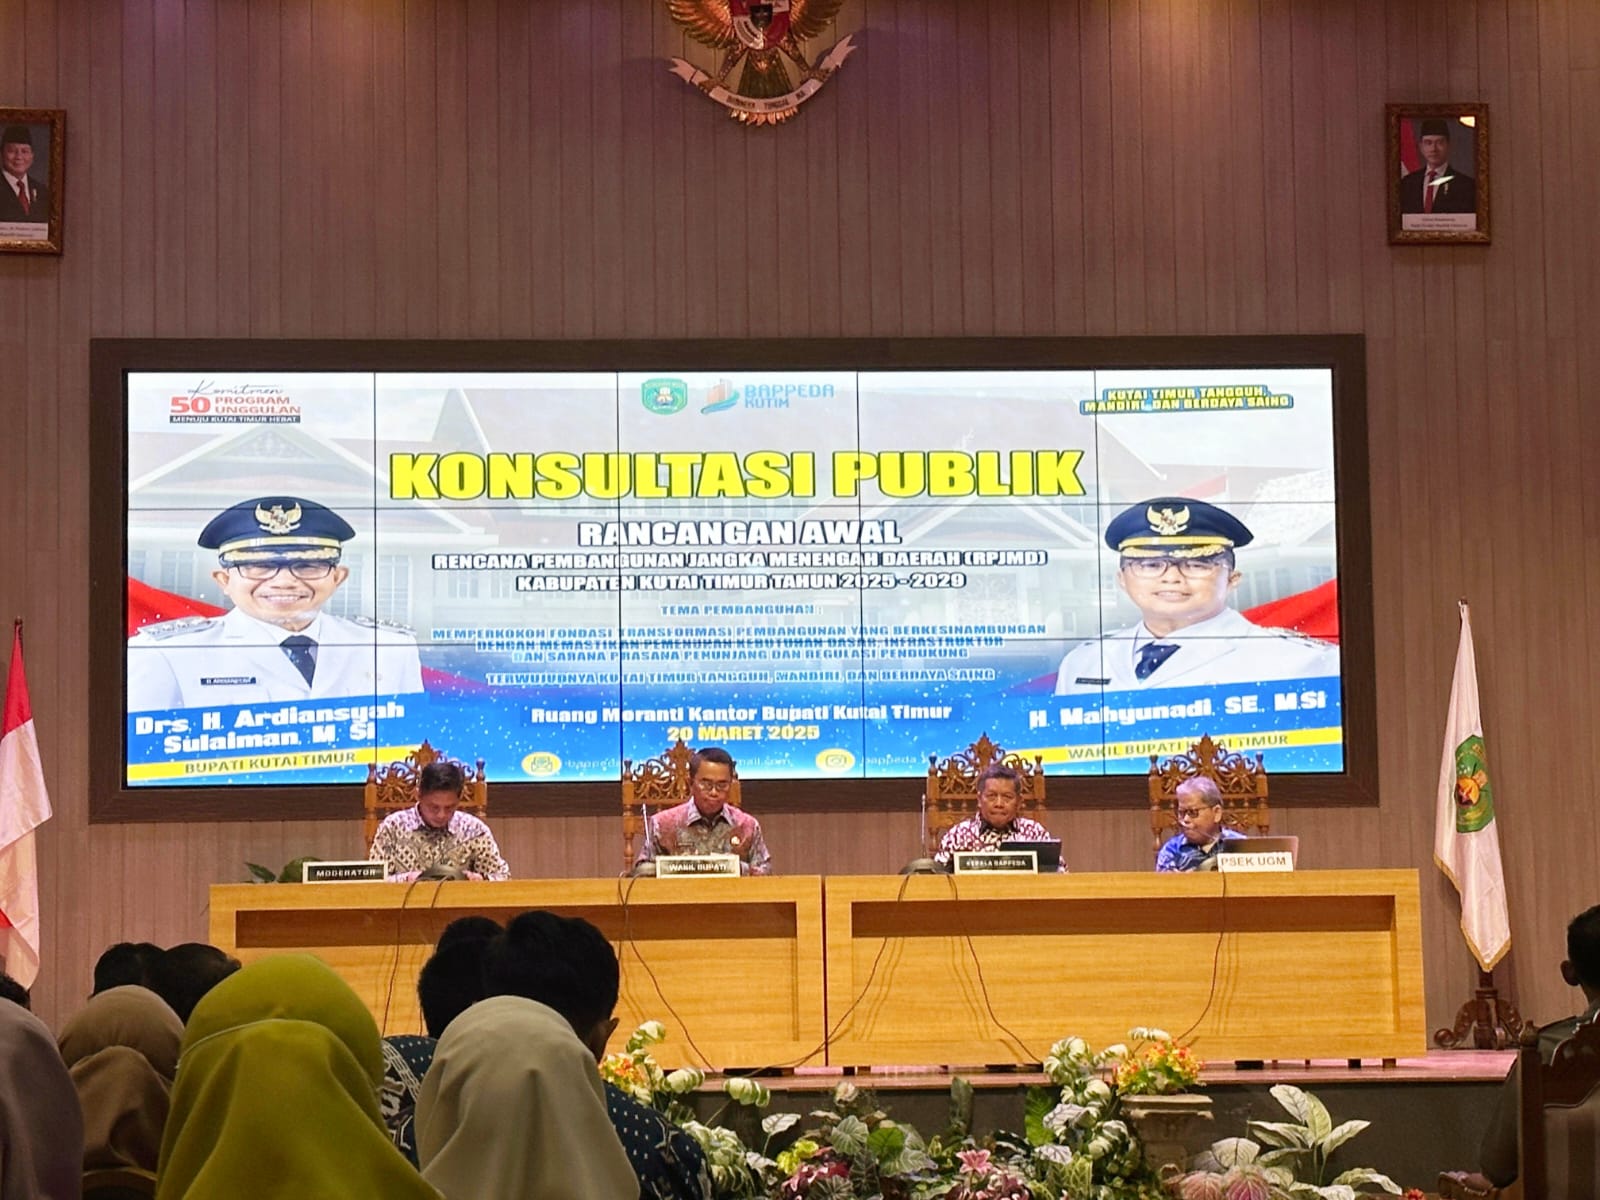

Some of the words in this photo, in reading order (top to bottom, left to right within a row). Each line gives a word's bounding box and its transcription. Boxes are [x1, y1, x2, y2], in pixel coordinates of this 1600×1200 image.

[744, 384, 835, 398] BAPPEDA
[1107, 388, 1148, 400] KUTAI
[1151, 387, 1196, 400] TIMUR
[170, 396, 212, 414] 50
[215, 396, 291, 405] PROGRAM
[745, 399, 790, 408] KUTIM
[1152, 399, 1180, 411] DAN
[1183, 397, 1244, 409] BERDAYA
[1246, 395, 1290, 408] SAING
[215, 406, 301, 414] UNGGULAN
[239, 415, 268, 423] TIMUR
[390, 451, 815, 500] KONSULTASI
[832, 450, 1087, 498] PUBLIK
[577, 520, 796, 546] RANCANGAN
[799, 519, 903, 545] AWAL
[432, 554, 529, 570] RENCANA
[529, 553, 687, 570] PEMBANGUNAN
[687, 552, 767, 568] JANGKA
[767, 551, 880, 568] MENENGAH
[881, 550, 962, 567] DAERAH
[962, 550, 1049, 566] (RPJMD)
[516, 575, 637, 591] KABUPATEN
[637, 574, 700, 591] KUTAI
[702, 573, 769, 590] TIMUR
[770, 573, 840, 590] TAHUN
[840, 572, 897, 589] 2025
[910, 571, 967, 589] 2029
[661, 605, 700, 615] TEMA
[704, 604, 815, 615] PEMBANGUNAN
[432, 628, 546, 640] MEMPERKOKOH
[549, 628, 613, 639] FONDASI
[618, 627, 732, 638] TRANSFORMASI
[736, 626, 846, 637] PEMBANGUNAN
[850, 625, 889, 636] YANG
[893, 624, 1046, 636] BERKESINAMBUNGAN
[476, 640, 536, 651] DENGAN
[540, 639, 640, 650] MEMASTIKAN
[644, 638, 732, 649] PEMENUHAN
[736, 637, 823, 648] KEBUTUHAN
[884, 635, 1004, 647] INFRASTRUKTUR
[513, 651, 543, 662] DAN
[547, 651, 606, 662] SARANA
[684, 650, 767, 660] PENUNJANG
[771, 649, 801, 660] DAN
[805, 648, 876, 659] REGULASI
[880, 647, 968, 658] PENDUKUNG
[599, 672, 644, 683] KUTAI
[648, 672, 695, 683] TIMUR
[847, 670, 878, 681] DAN
[881, 670, 946, 681] BERDAYA
[234, 701, 405, 728] Ardiansyah
[530, 707, 598, 724] Ruang
[689, 705, 758, 721] Kantor
[761, 704, 830, 722] Bupati
[833, 704, 888, 720] Kutai
[891, 704, 953, 719] Timur
[666, 726, 694, 742] 20
[697, 725, 764, 741] MARET
[766, 724, 820, 740] 2025
[1067, 745, 1120, 760] WAKIL
[1124, 741, 1182, 756] BUPATI
[1237, 734, 1289, 748] TIMUR
[185, 759, 245, 774] BUPATI
[249, 757, 298, 769] KUTAI
[301, 752, 357, 765] TIMUR
[668, 863, 696, 871] WAKIL
[697, 863, 727, 871] BUPATI
[1221, 856, 1255, 867] PSEK
[1257, 856, 1286, 866] UGM
[315, 868, 377, 877] MODERATOR
